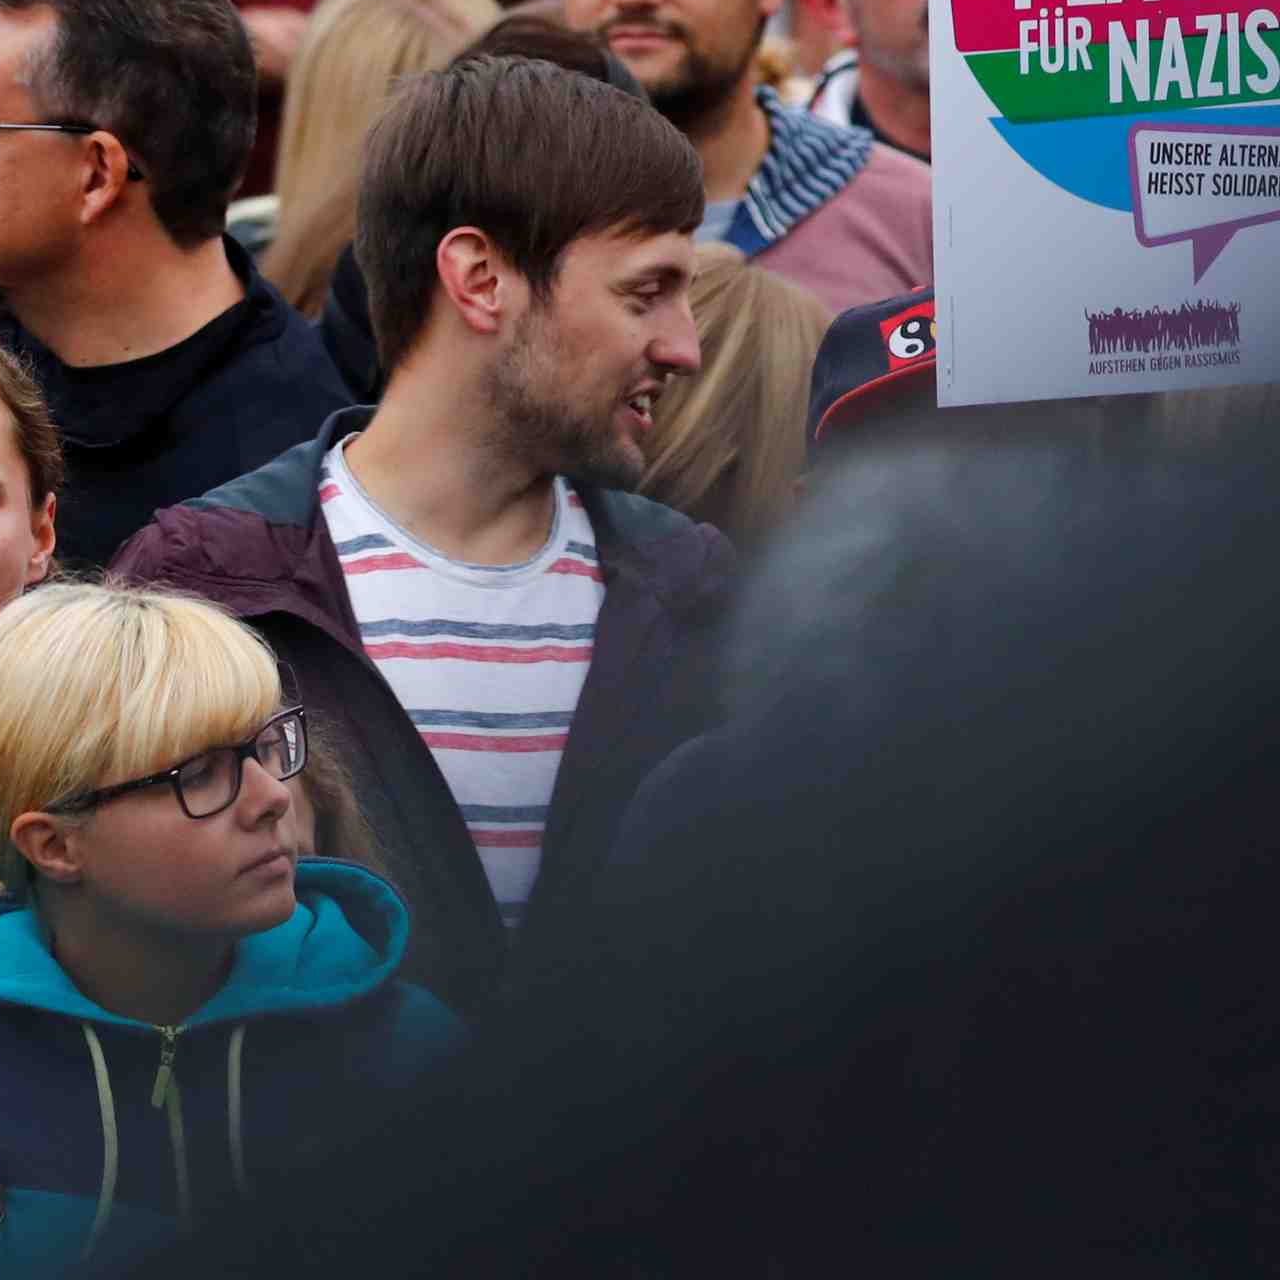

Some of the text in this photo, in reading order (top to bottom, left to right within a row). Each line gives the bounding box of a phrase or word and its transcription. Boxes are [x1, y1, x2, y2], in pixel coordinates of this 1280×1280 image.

[1018, 6, 1280, 104] FÜR NAZIS
[1149, 141, 1280, 168] UNSERE ALTERN
[1147, 171, 1205, 196] HEISST
[1089, 350, 1241, 376] AUFSTEHEN GEGEN RASSISMUS
